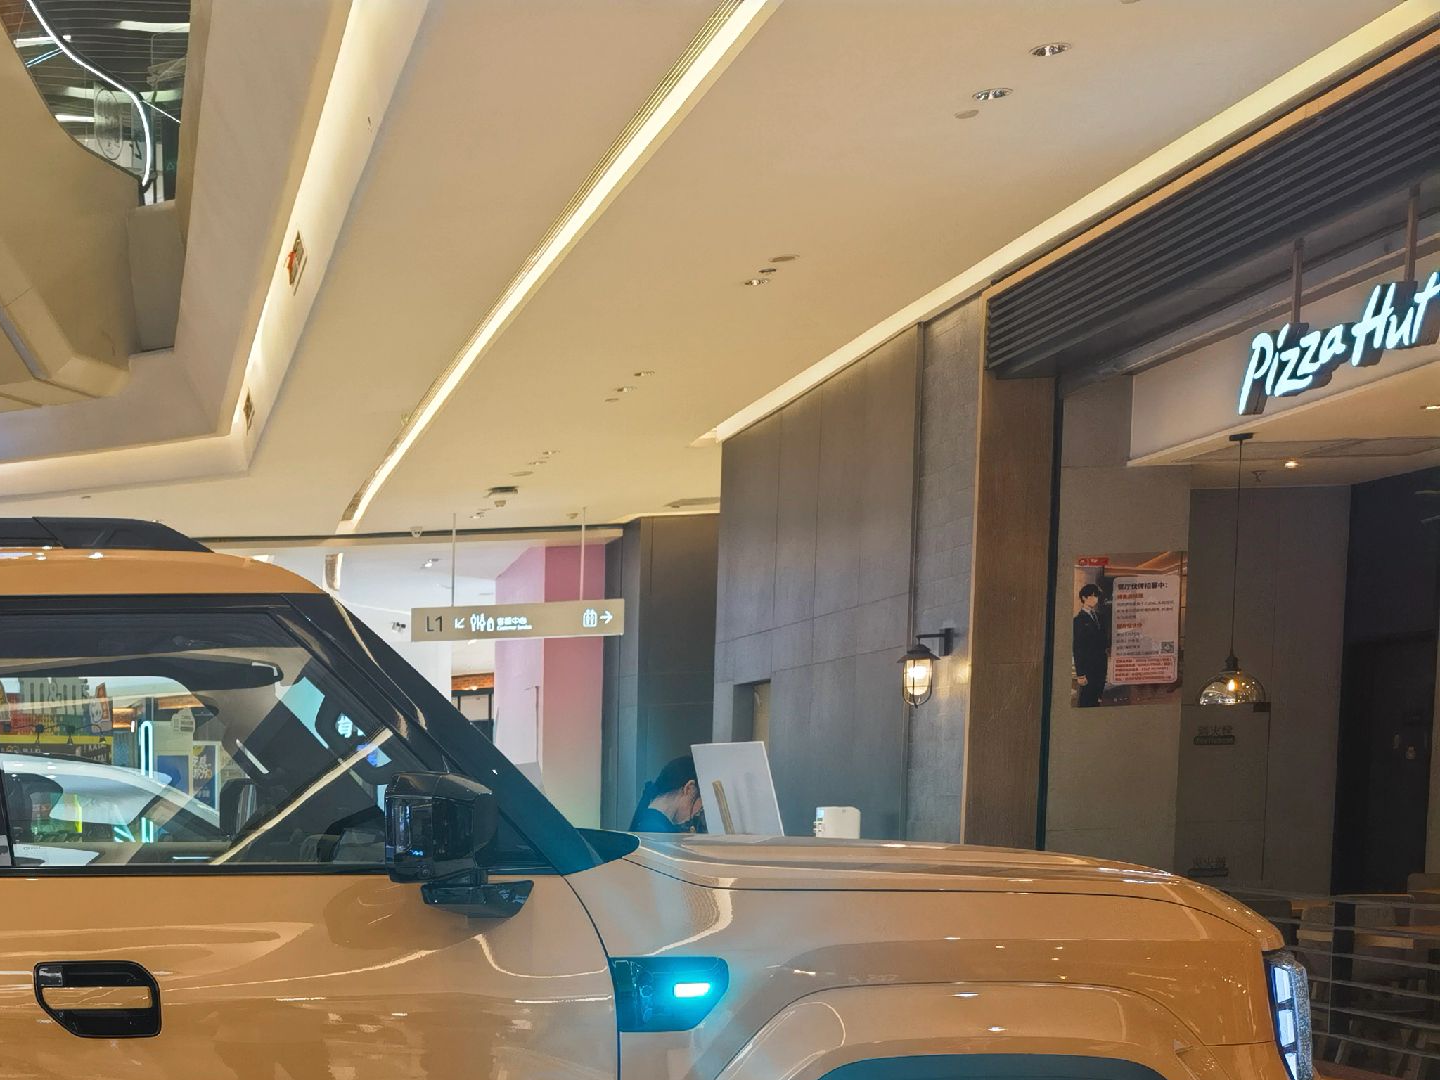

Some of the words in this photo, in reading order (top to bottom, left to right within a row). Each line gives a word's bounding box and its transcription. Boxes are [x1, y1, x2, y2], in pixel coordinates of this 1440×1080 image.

[1238, 322, 1347, 415] Pizza
[1351, 271, 1440, 367] Hut
[426, 614, 444, 633] L1
